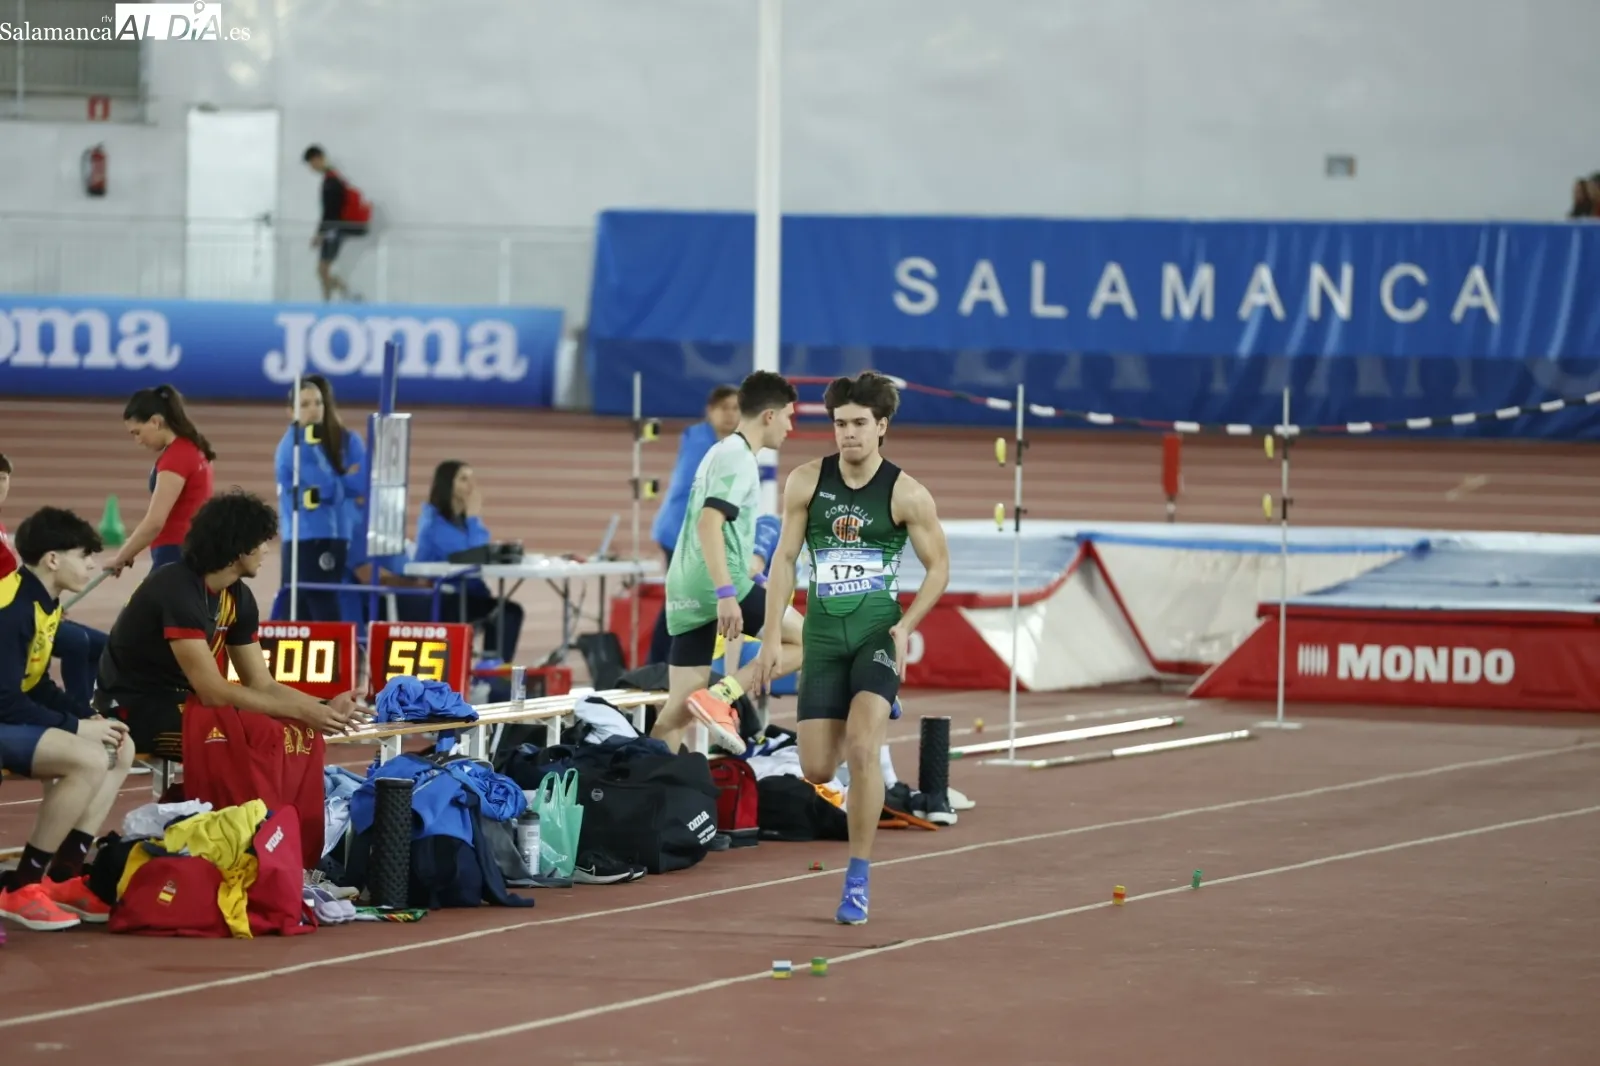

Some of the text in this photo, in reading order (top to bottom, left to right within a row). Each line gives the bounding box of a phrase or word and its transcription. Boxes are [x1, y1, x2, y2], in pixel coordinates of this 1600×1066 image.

[892, 257, 1501, 324] SALAMANCA
[263, 312, 528, 383] Joma
[829, 579, 872, 596] Joma
[830, 564, 865, 580] 179
[389, 626, 448, 639] MONDO
[386, 641, 447, 682] 55
[1337, 643, 1516, 685] MONDO
